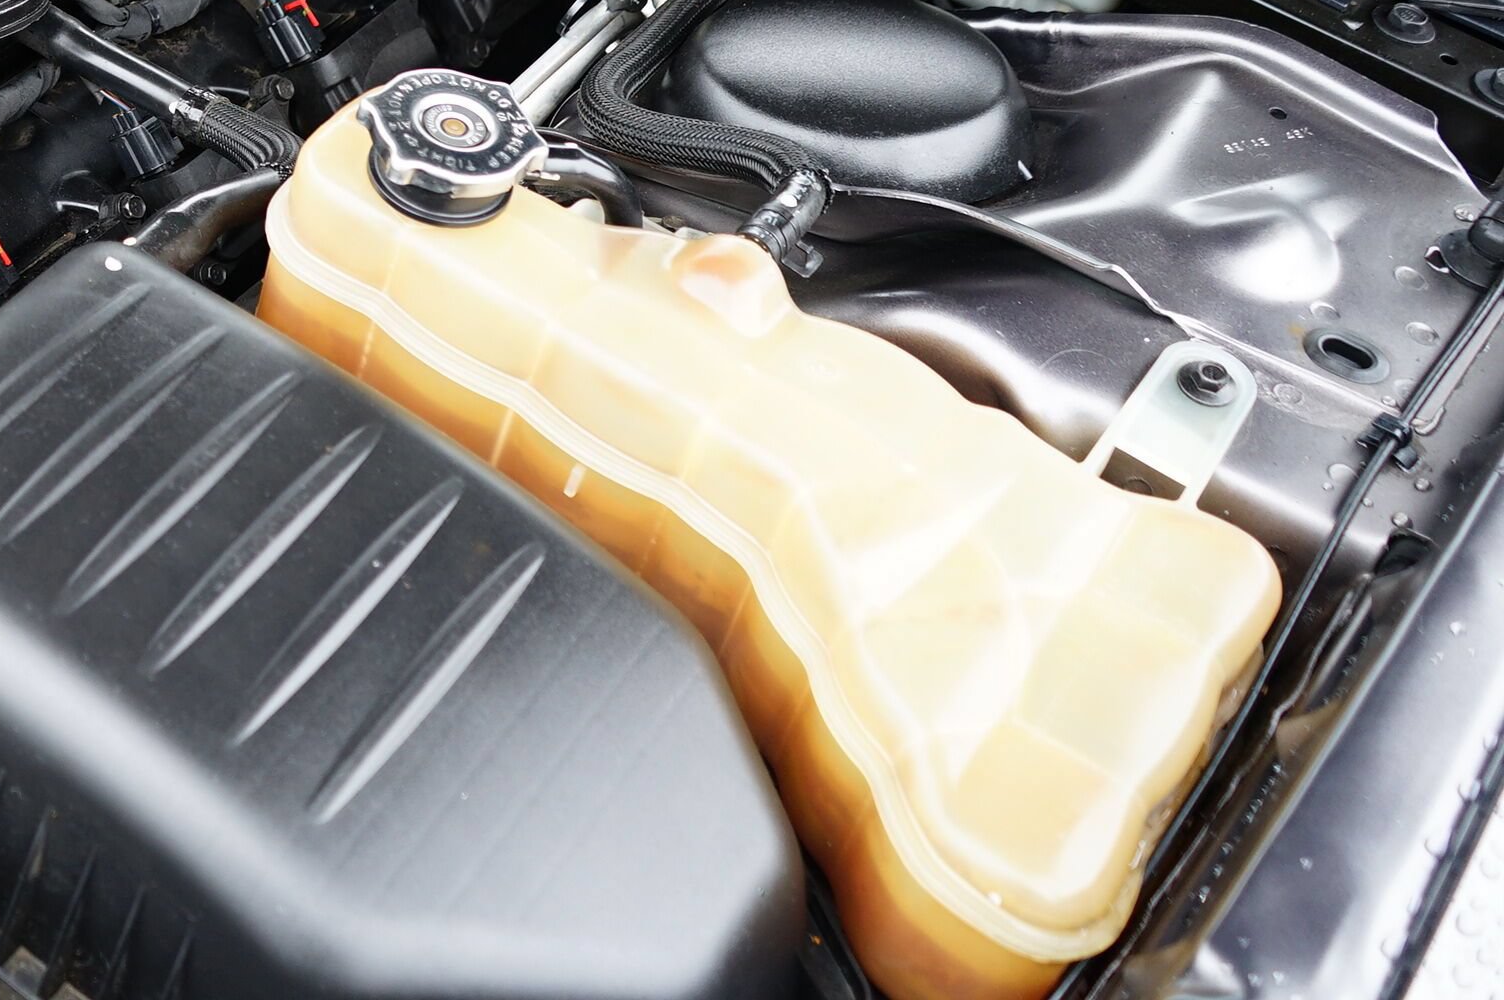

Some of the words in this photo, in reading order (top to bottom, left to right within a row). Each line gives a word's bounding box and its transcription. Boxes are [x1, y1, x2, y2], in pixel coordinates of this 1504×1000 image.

[398, 73, 442, 94] OPEN
[447, 75, 488, 92] NOT
[487, 90, 512, 108] DO
[496, 111, 528, 122] TVS
[416, 148, 478, 172] TIGHT
[488, 136, 524, 169] KEEP
